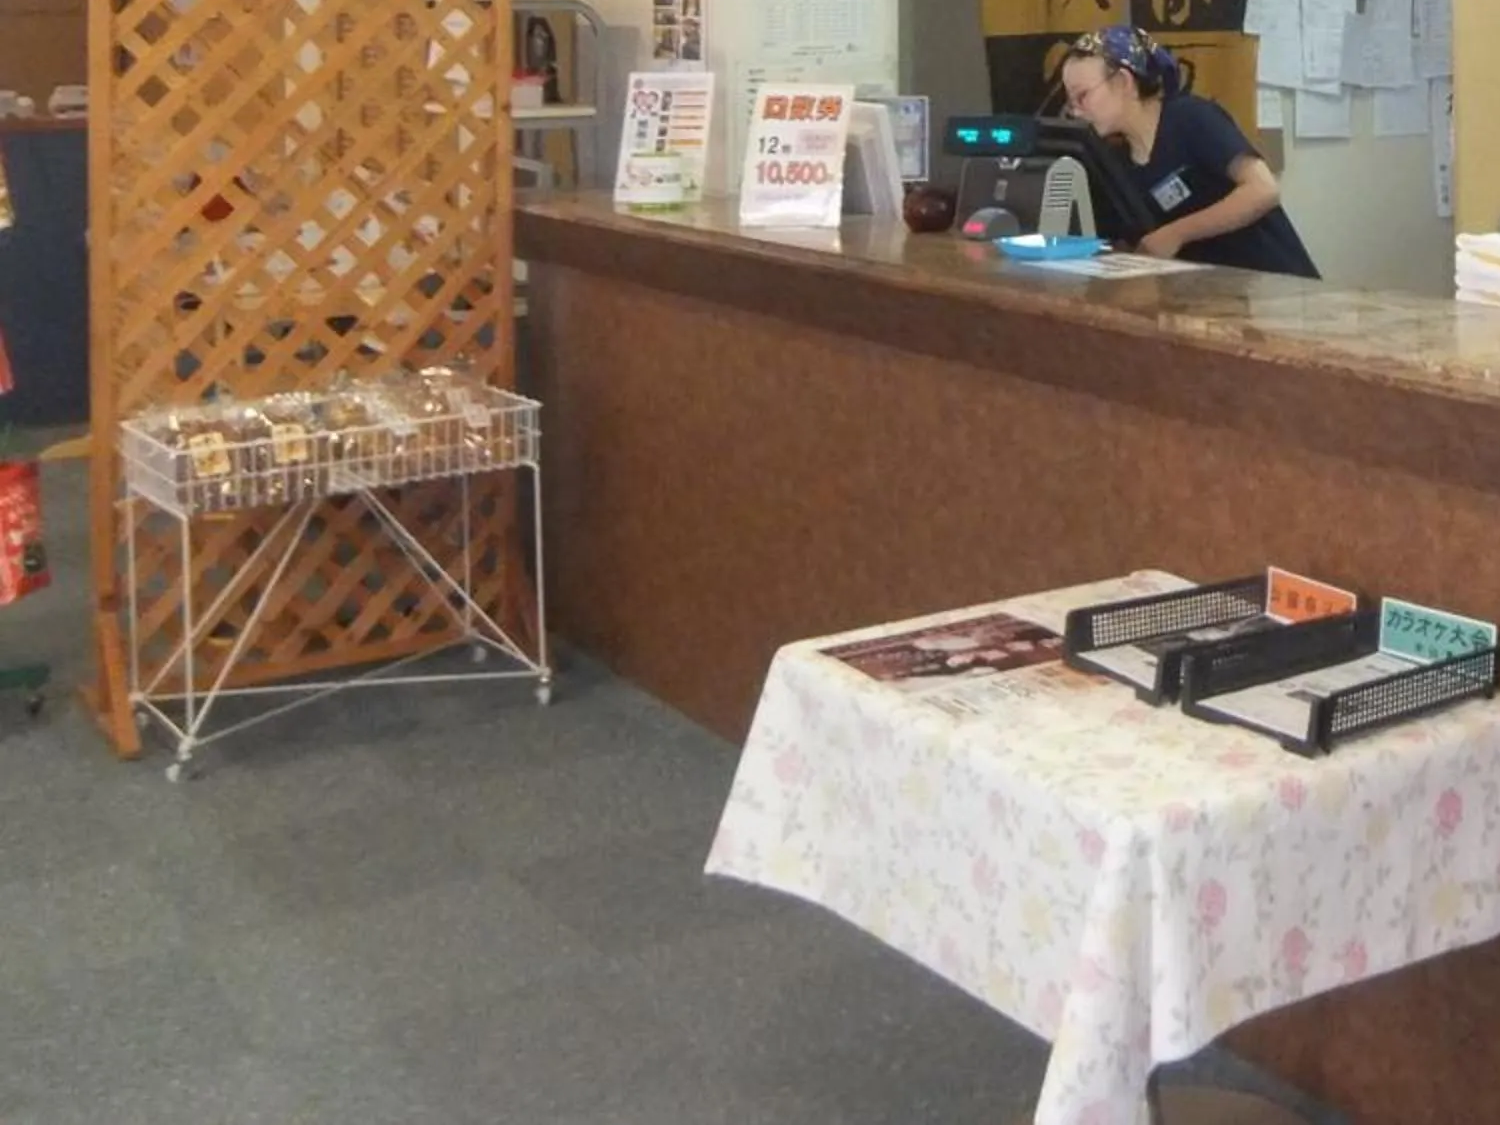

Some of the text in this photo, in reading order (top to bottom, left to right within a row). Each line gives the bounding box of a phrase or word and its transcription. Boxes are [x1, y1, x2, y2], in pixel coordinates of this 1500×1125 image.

[1386, 607, 1490, 651] カラオケ大会
